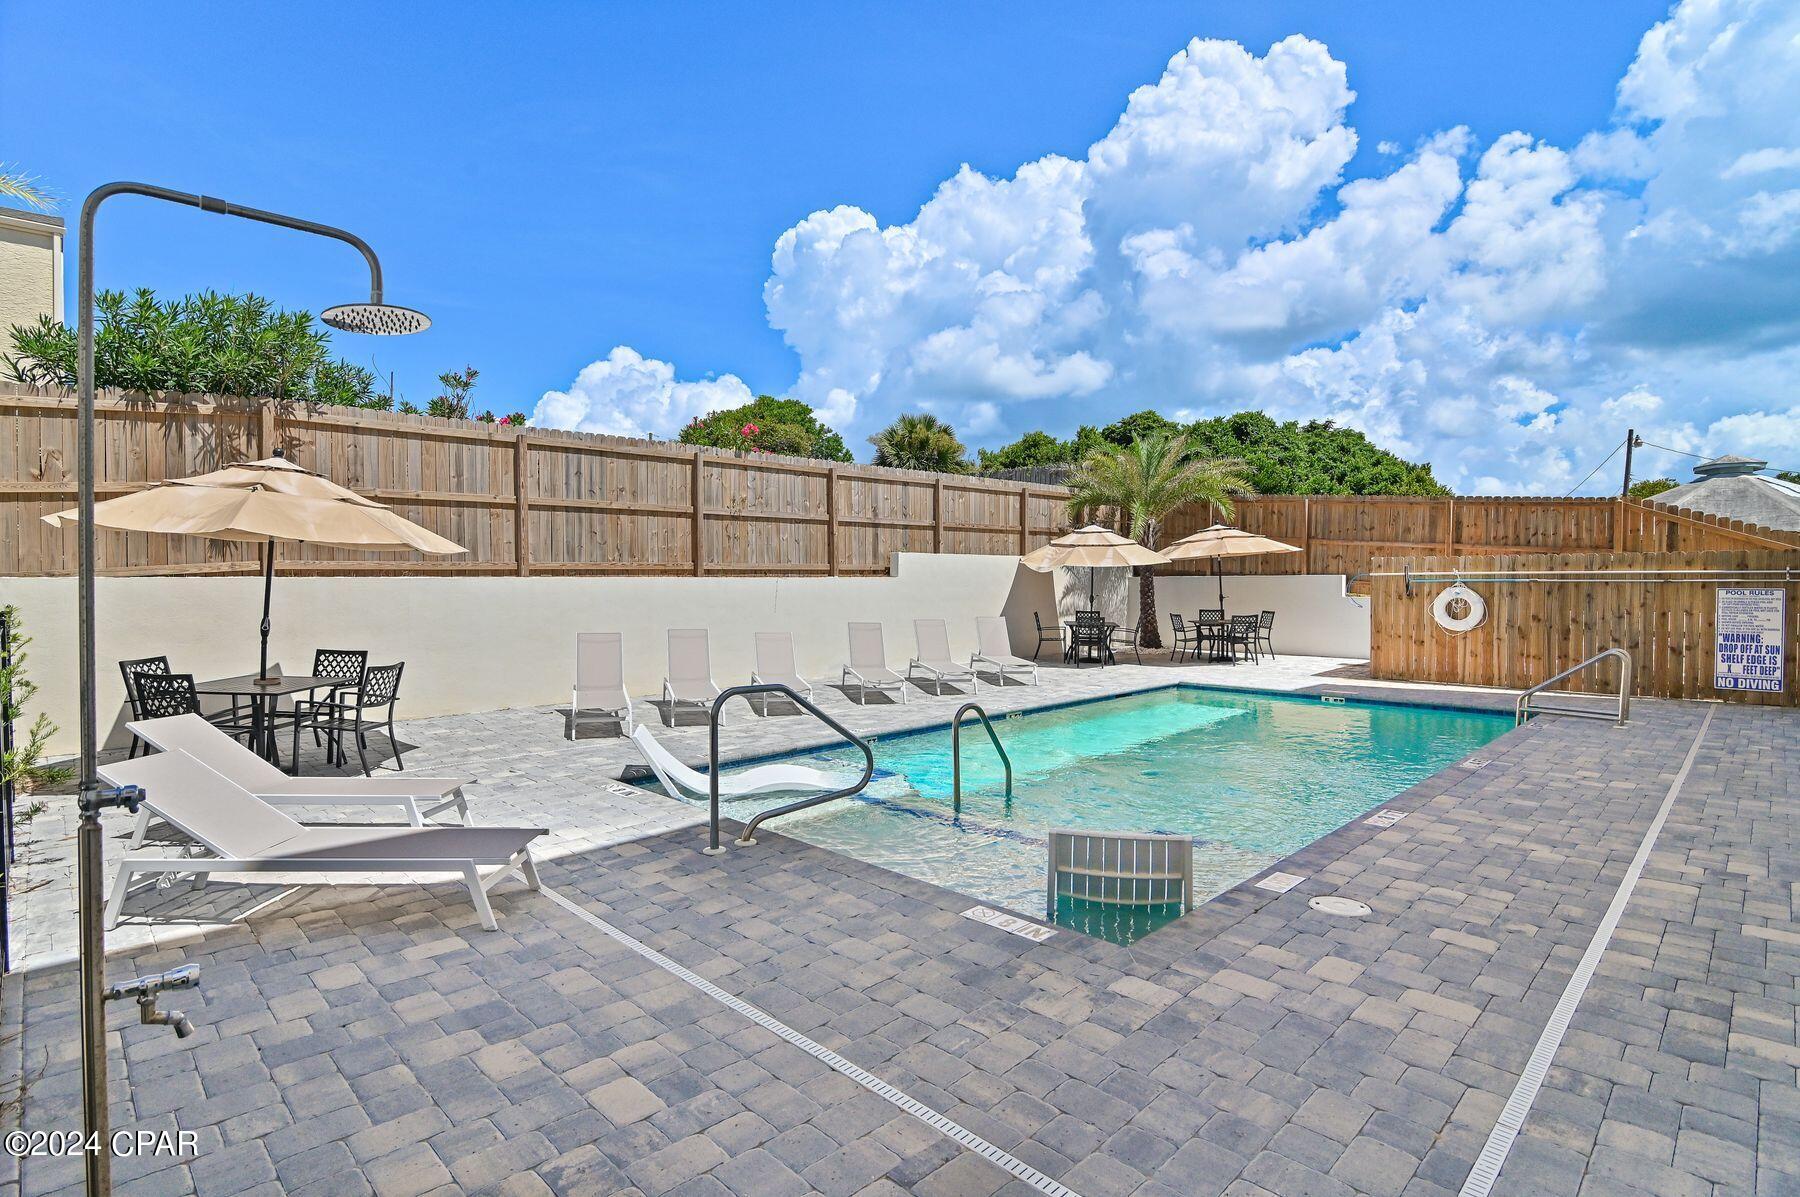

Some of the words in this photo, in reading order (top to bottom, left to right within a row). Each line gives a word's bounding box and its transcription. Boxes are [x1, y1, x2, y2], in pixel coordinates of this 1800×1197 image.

[1719, 633, 1764, 644] "WARNING:
[1719, 643, 1739, 653] DROP
[1740, 644, 1753, 654] OFF
[1754, 645, 1763, 654] AT
[1765, 645, 1780, 655] SUN
[1721, 654, 1744, 664] SHELF
[1746, 655, 1766, 665] EDGE
[1769, 656, 1778, 665] IS
[1743, 665, 1758, 675] FEET
[1759, 666, 1780, 676] DEEP"
[1717, 677, 1734, 688] NO
[1738, 678, 1780, 691] DIVING
